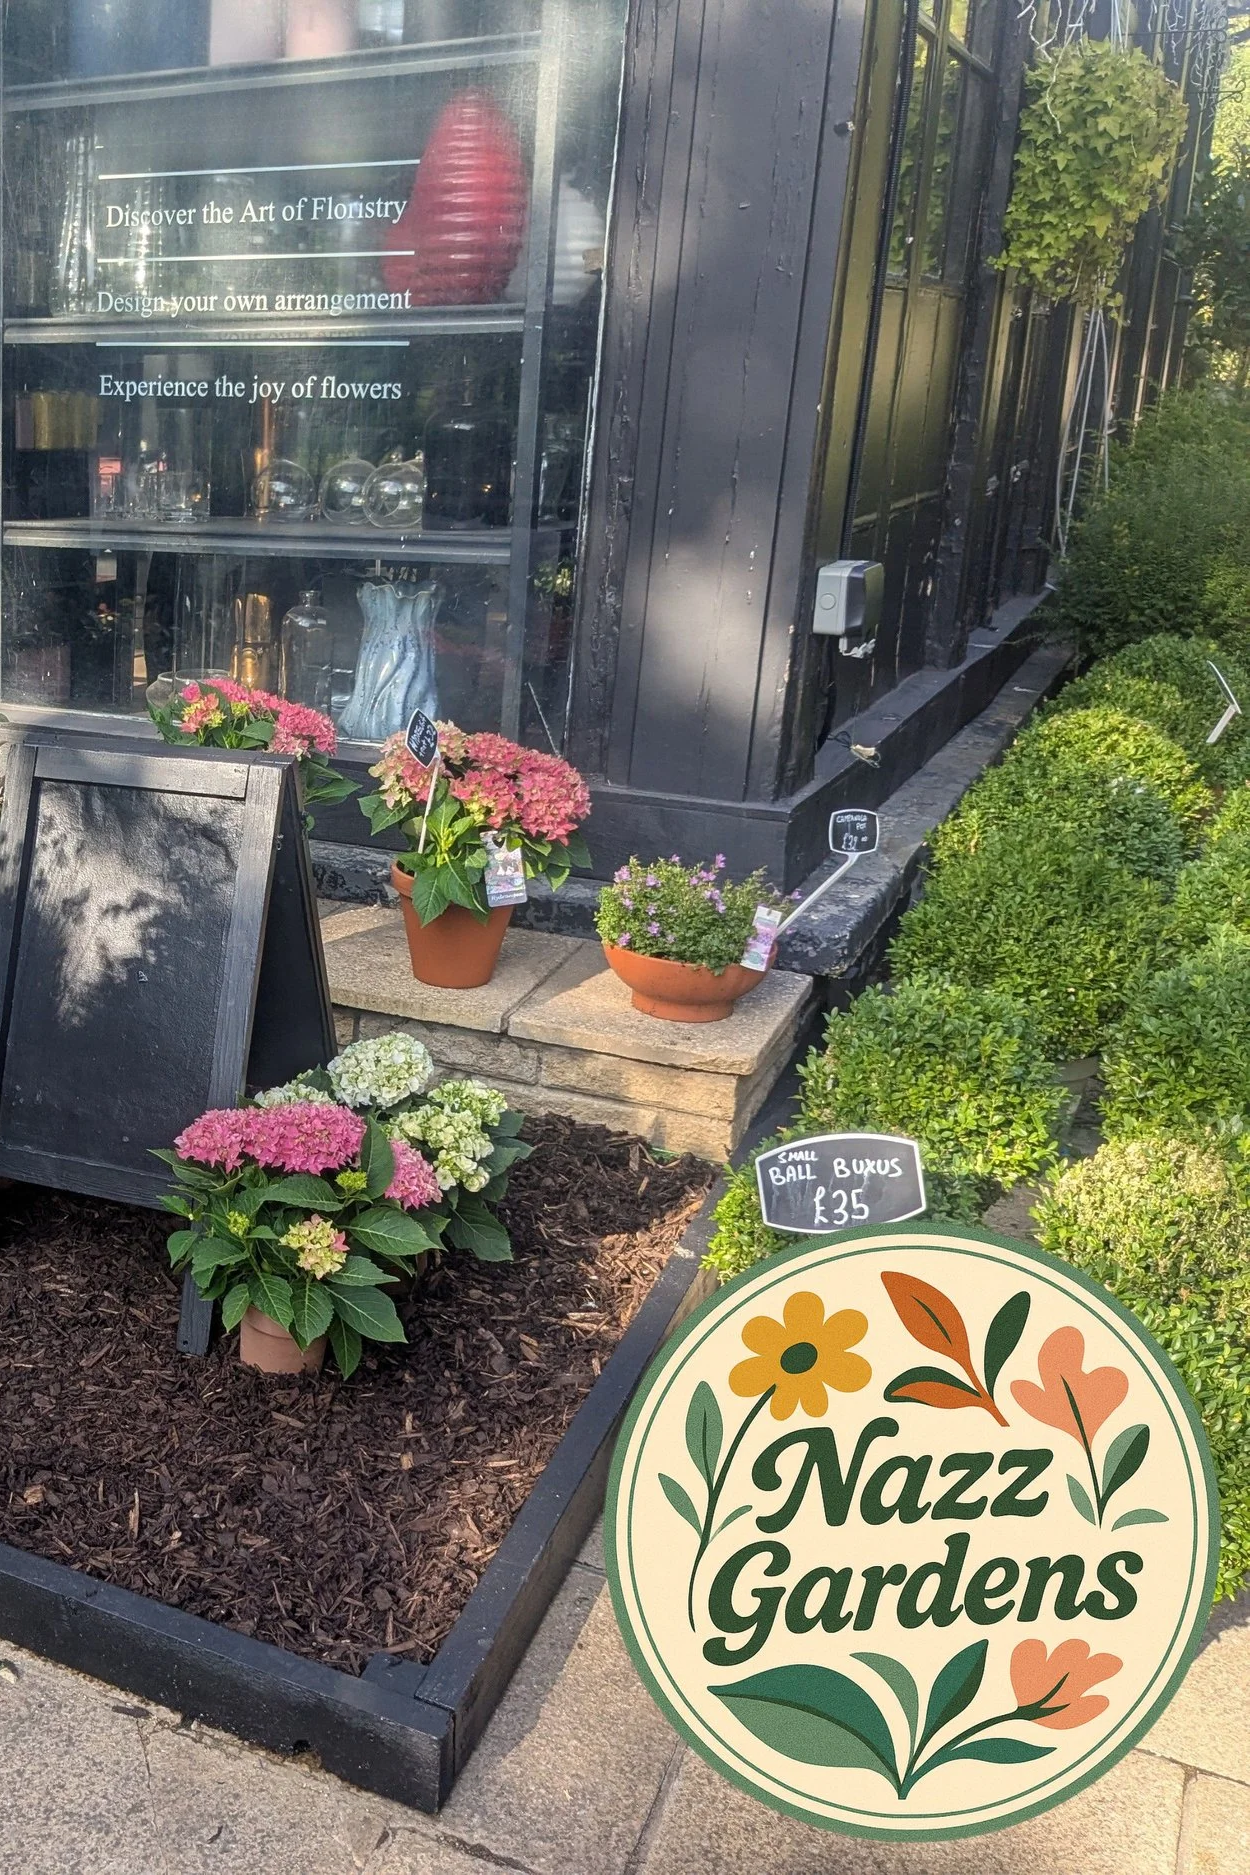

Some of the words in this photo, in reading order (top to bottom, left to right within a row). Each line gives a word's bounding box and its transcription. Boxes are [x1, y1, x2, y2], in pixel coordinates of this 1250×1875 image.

[106, 203, 197, 228] Discover
[202, 200, 234, 224] the
[239, 199, 276, 223] Art
[281, 197, 308, 222] of
[310, 194, 408, 224] Floristry
[97, 291, 164, 318] Design
[170, 293, 219, 318] your
[223, 293, 268, 312] own
[274, 288, 412, 317] arrangement
[99, 373, 209, 402] Experience
[214, 374, 246, 398] the
[249, 374, 286, 404] joy
[291, 375, 317, 399] of
[320, 375, 402, 400] flowers
[768, 1163, 817, 1185] BALL
[833, 1157, 903, 1179] BUXUS
[777, 1150, 819, 1164] SMALL
[813, 1185, 870, 1226] £35
